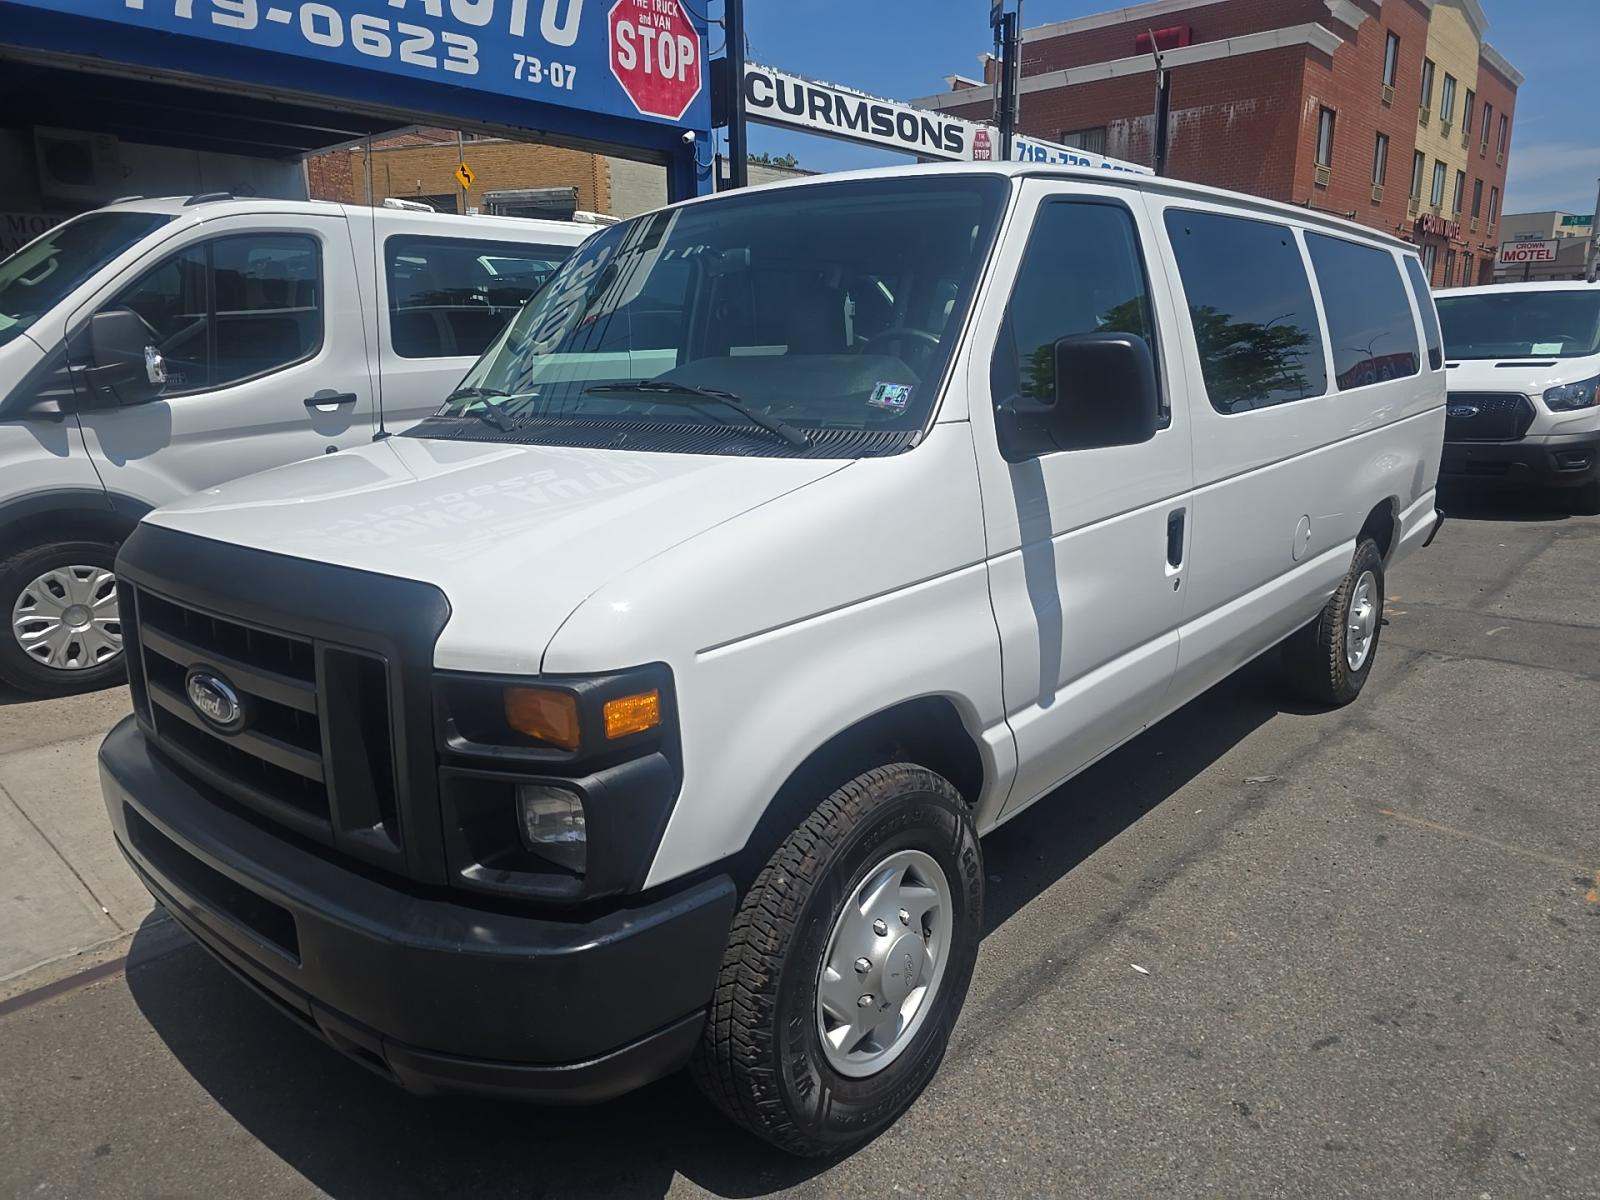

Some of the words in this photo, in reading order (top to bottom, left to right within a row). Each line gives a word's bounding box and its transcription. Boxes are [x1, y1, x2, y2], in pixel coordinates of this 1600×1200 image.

[639, 12, 651, 26] and
[654, 14, 671, 30] VAN
[126, 0, 480, 75] 9-0623
[616, 20, 695, 82] STOP
[512, 53, 577, 91] 73-07
[745, 71, 965, 155] CURMSONS
[974, 149, 990, 160] STOP
[1503, 249, 1553, 261] MOTEL
[1515, 242, 1546, 250] CROWN
